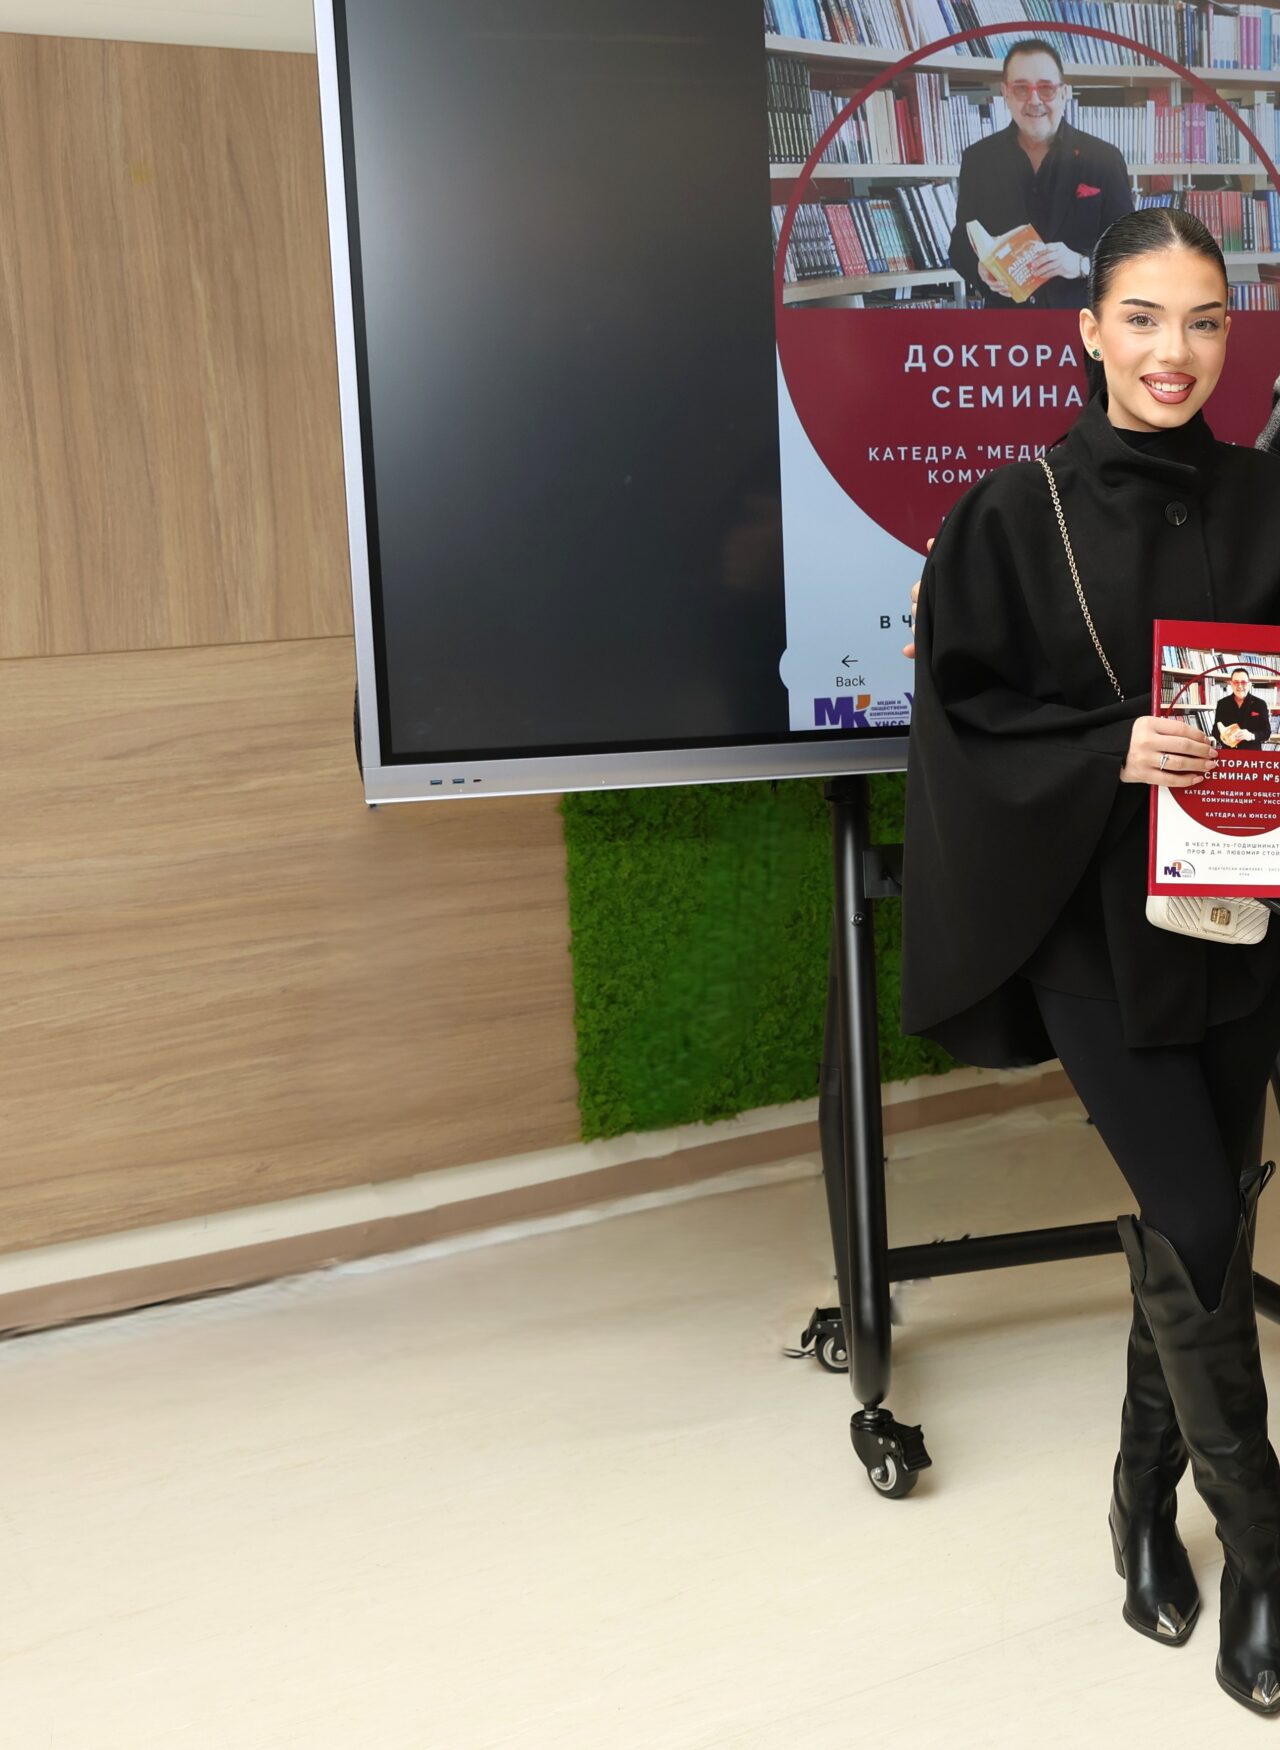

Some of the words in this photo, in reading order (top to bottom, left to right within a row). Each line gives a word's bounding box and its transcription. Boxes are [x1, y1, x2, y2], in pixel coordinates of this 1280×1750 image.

[904, 344, 1078, 373] ДОКТОРА
[931, 385, 1083, 409] СЕМИНА
[868, 446, 967, 464] КАТЕДРА
[977, 444, 1046, 462] "МЕДИ
[928, 469, 986, 484] КОМУ
[880, 616, 891, 629] В
[902, 615, 912, 628] Ч
[836, 675, 866, 687] Back
[1204, 772, 1258, 781] СЕМИНАР
[1263, 773, 1280, 783] №5
